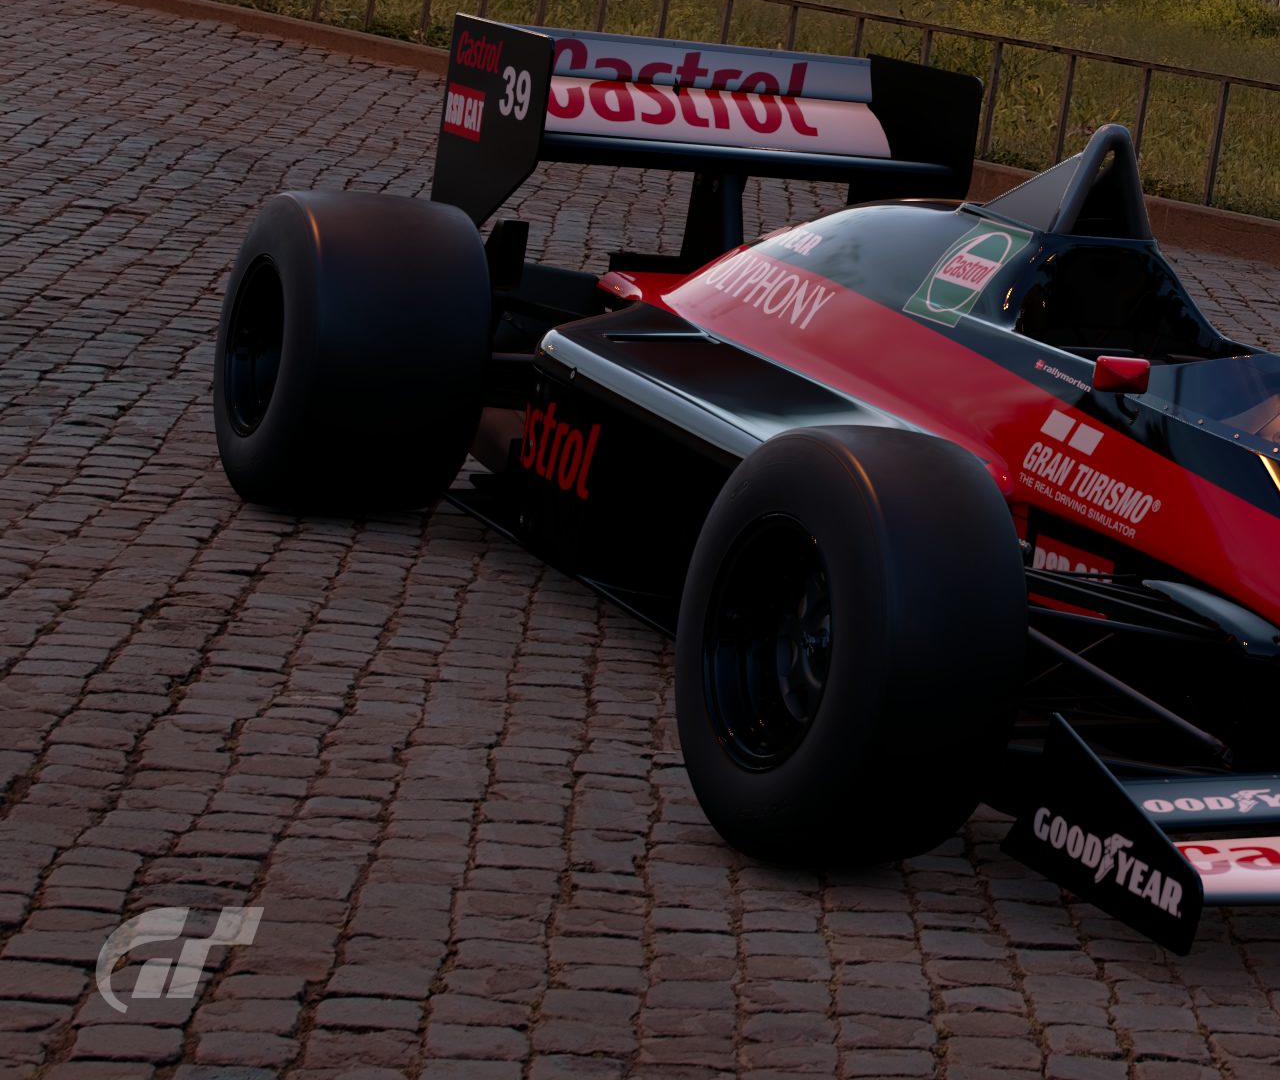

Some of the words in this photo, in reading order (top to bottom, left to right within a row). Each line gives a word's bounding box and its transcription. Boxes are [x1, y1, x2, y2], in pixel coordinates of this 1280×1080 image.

[456, 29, 503, 73] Castrol
[498, 65, 532, 121] 39
[547, 38, 818, 137] Castrol
[706, 254, 836, 330] OLYPHONY
[943, 255, 996, 285] Castrol
[1043, 364, 1092, 393] rallymorten
[520, 402, 602, 500] strol
[1022, 441, 1077, 487] GRAN
[1019, 472, 1035, 488] THE
[1033, 480, 1054, 500] REAL
[1054, 491, 1087, 516] DRIVING
[1087, 508, 1137, 539] SIMULATOR
